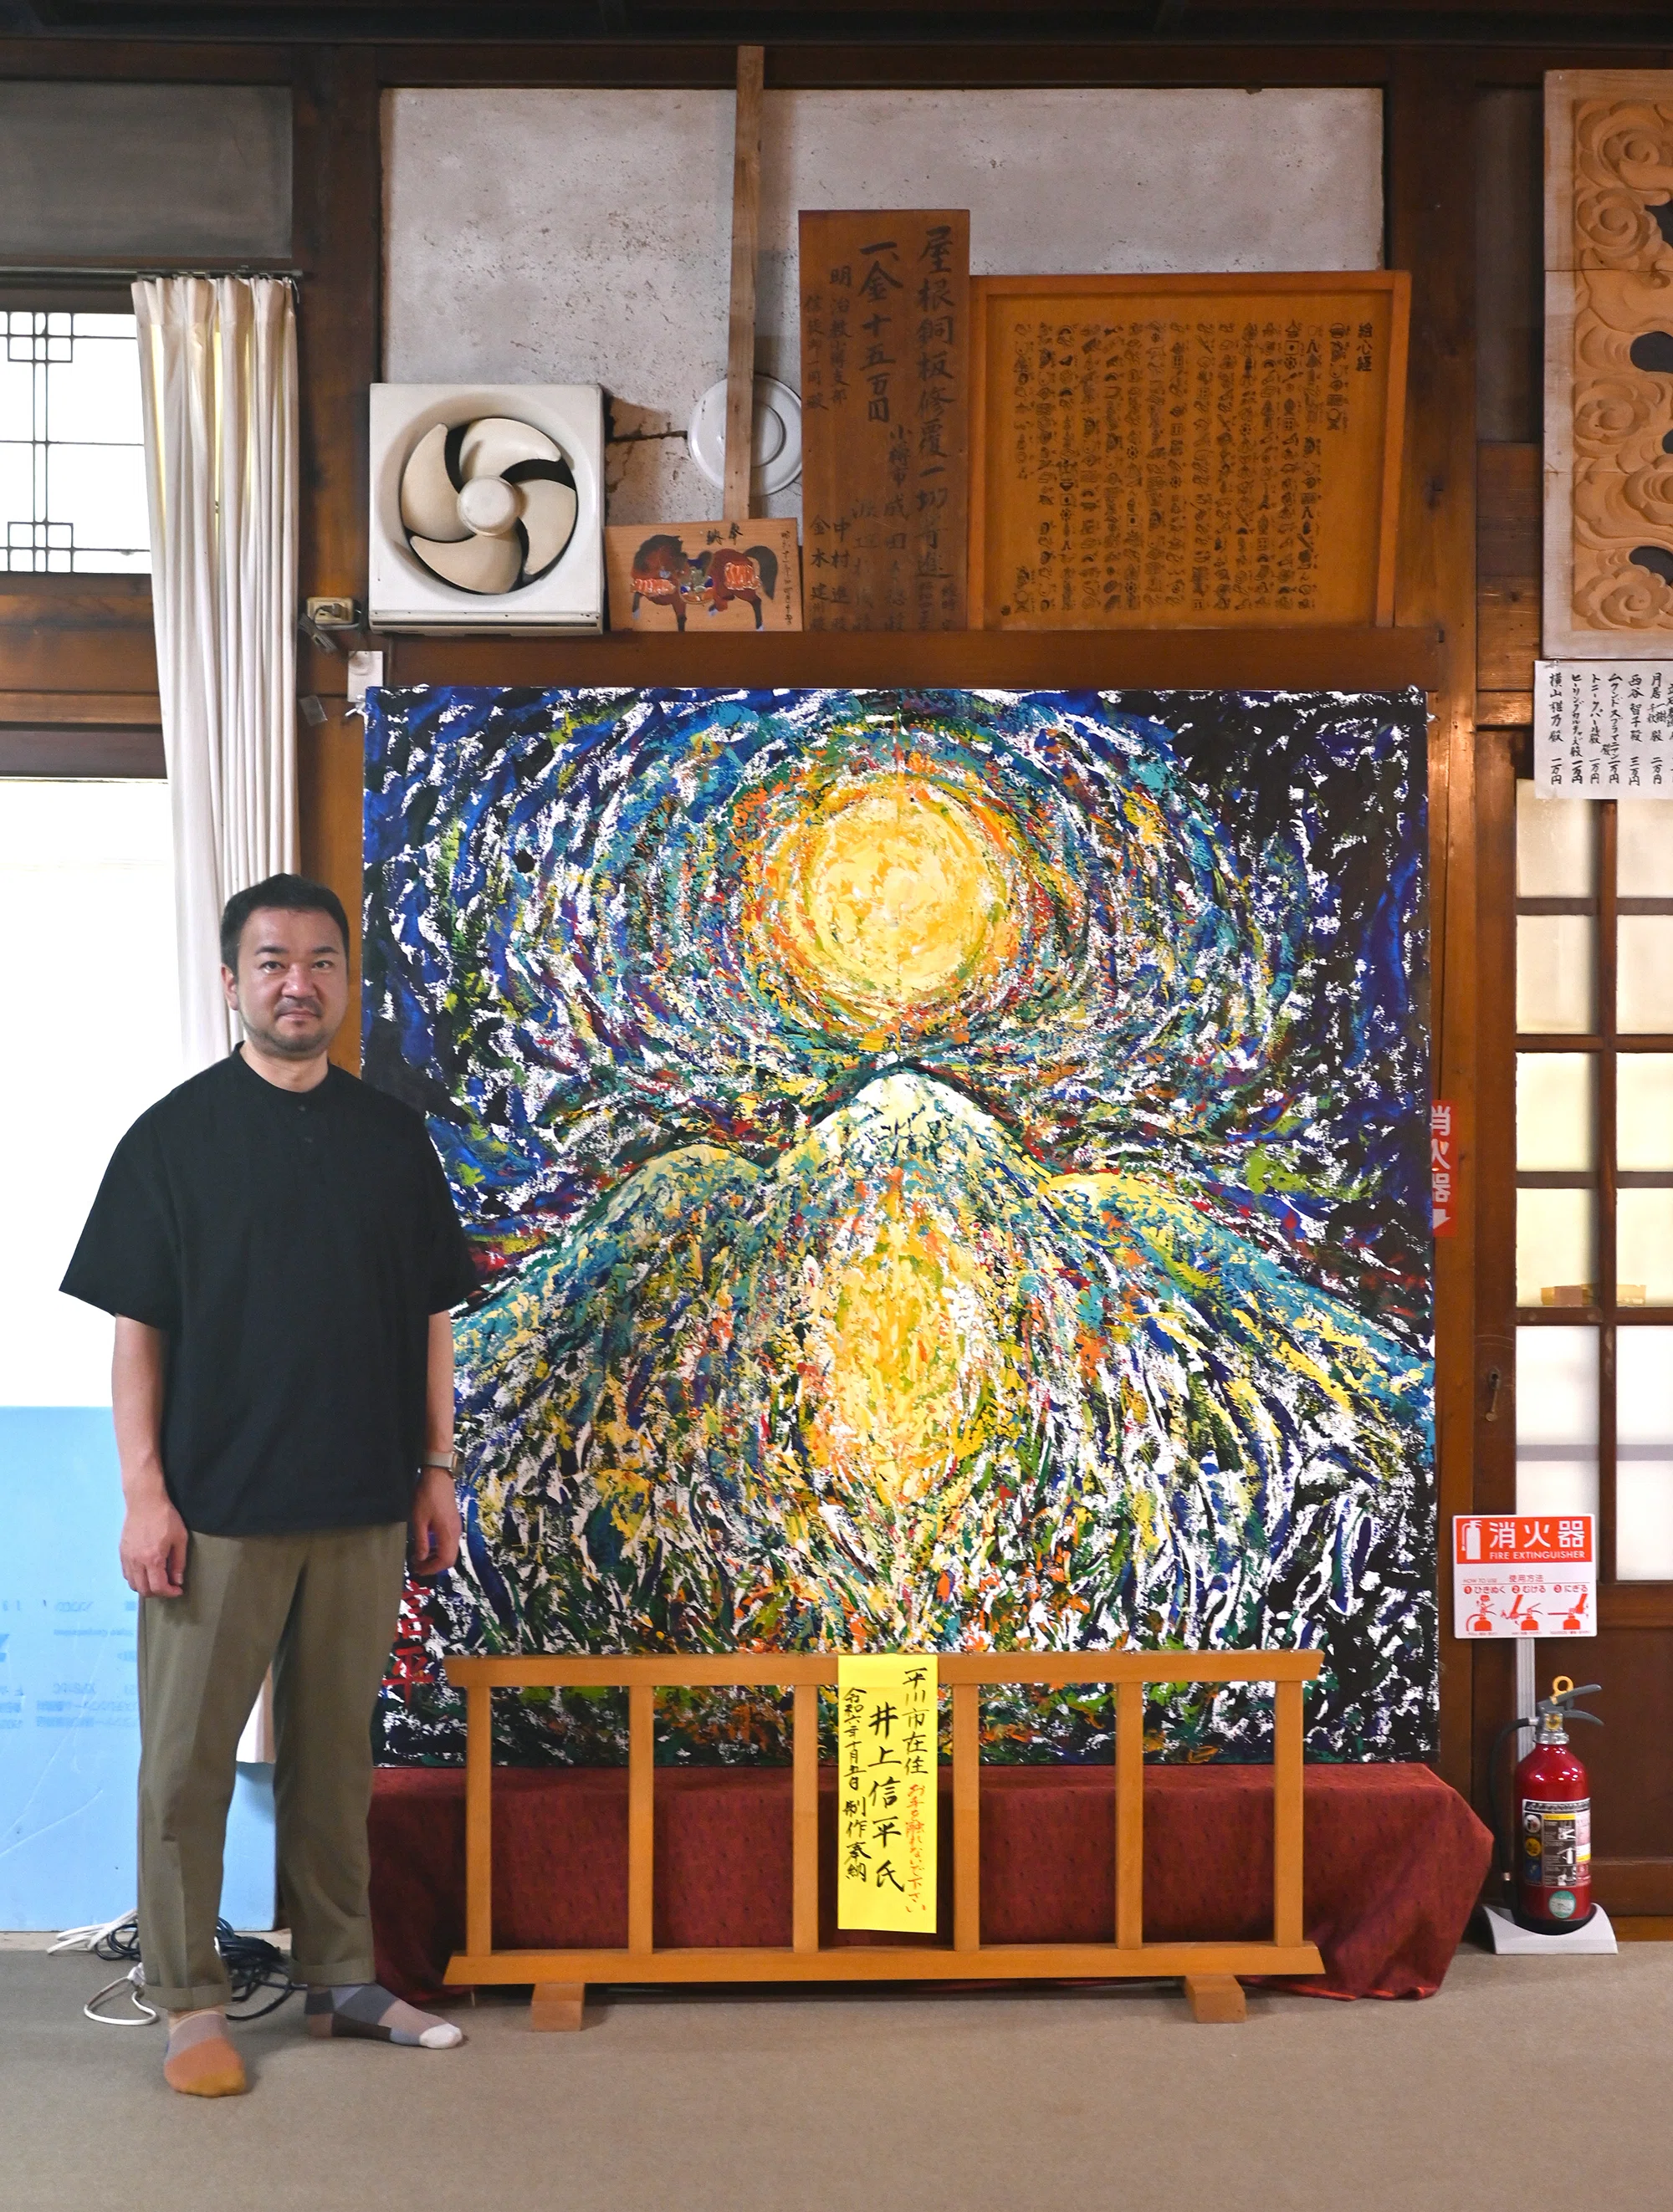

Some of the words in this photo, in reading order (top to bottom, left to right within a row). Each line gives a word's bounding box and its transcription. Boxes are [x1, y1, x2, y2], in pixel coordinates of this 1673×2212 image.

[1489, 1520, 1585, 1549] 消火器
[1489, 1551, 1509, 1560] FIRE
[1512, 1550, 1585, 1560] EXTINGUISHER
[902, 1667, 930, 1775] 平川市在住
[867, 1701, 905, 1893] 井上信平氏
